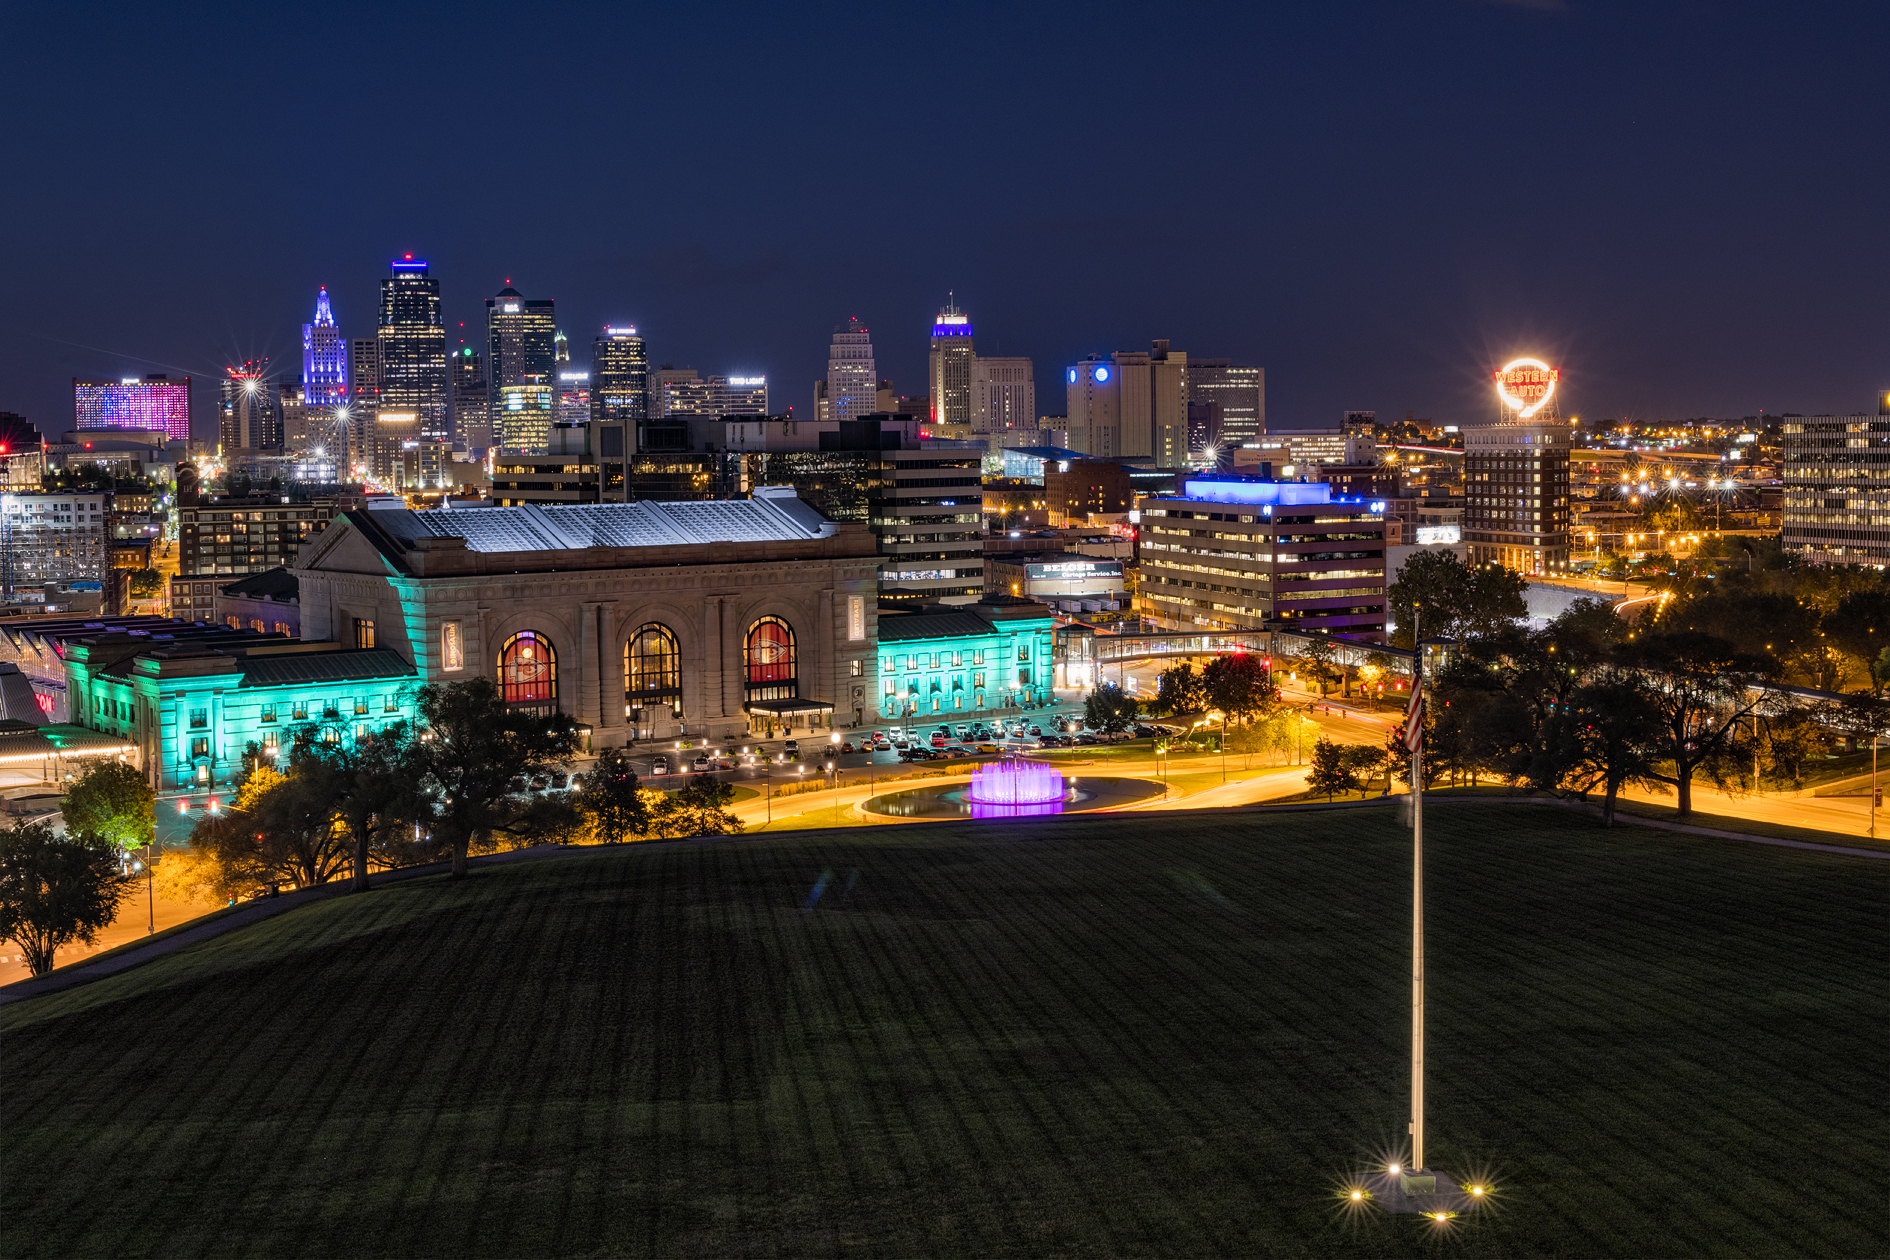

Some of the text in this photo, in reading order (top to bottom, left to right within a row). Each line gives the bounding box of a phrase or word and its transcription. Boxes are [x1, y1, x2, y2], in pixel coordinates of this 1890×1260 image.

[1495, 370, 1558, 383] WESTERN
[1509, 385, 1546, 397] AUTO
[1043, 564, 1095, 572] BELGER
